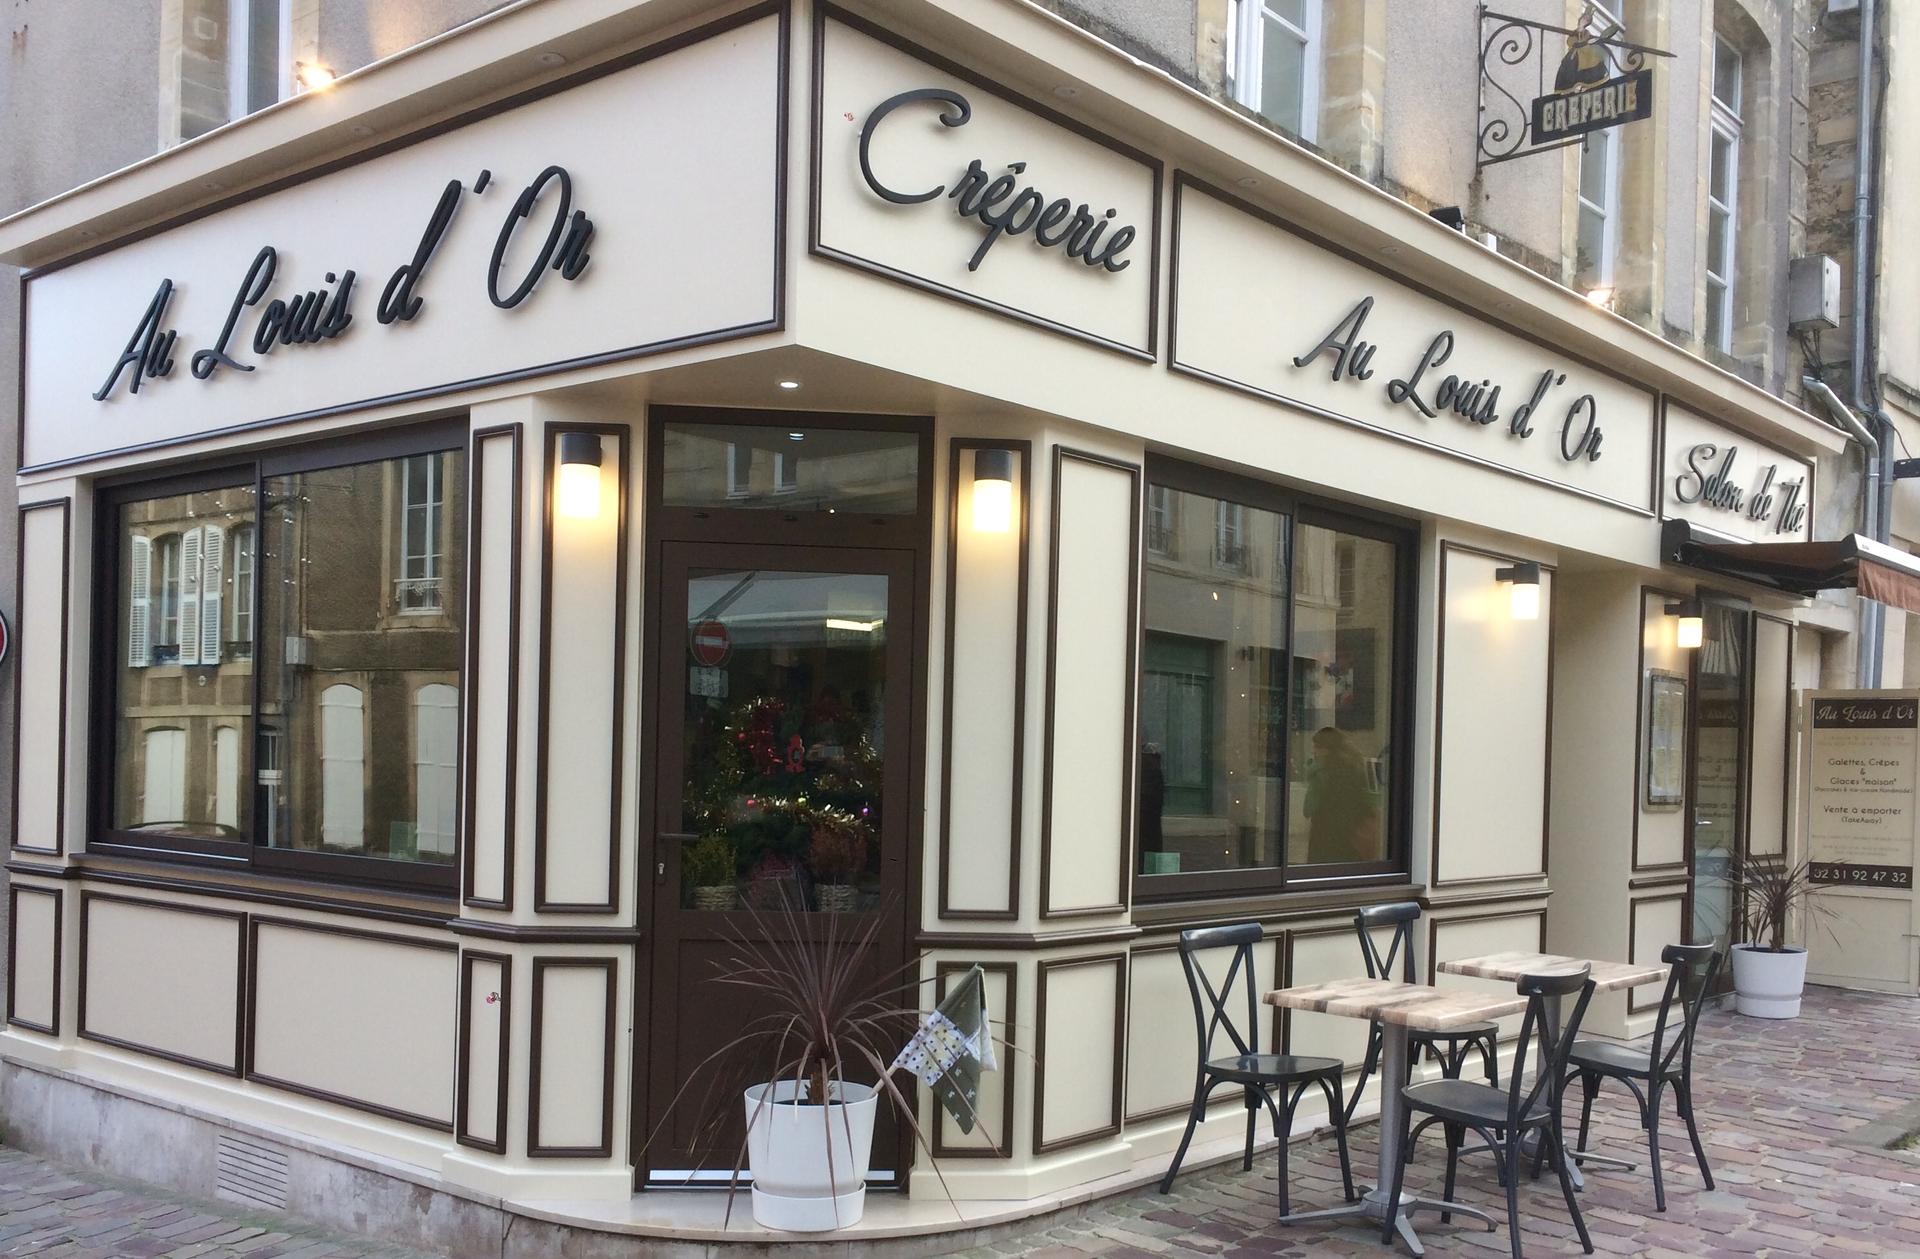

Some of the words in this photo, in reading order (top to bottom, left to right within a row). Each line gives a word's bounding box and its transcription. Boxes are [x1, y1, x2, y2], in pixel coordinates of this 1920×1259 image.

[92, 278, 177, 401] Au
[191, 245, 356, 380] Louis
[1293, 296, 1377, 381] Au
[1388, 330, 1501, 425] Louis
[1750, 464, 1777, 521] de
[1816, 705, 1838, 720] Au
[1842, 705, 1877, 723] Louis
[1829, 776, 1860, 786] Glaces
[1823, 804, 1849, 814] Vente
[1851, 806, 1859, 815] à
[1860, 806, 1902, 816] emporter
[1833, 868, 1847, 880] 31
[1851, 869, 1868, 881] 92
[1872, 871, 1887, 882] 47
[1891, 872, 1907, 884] 32
